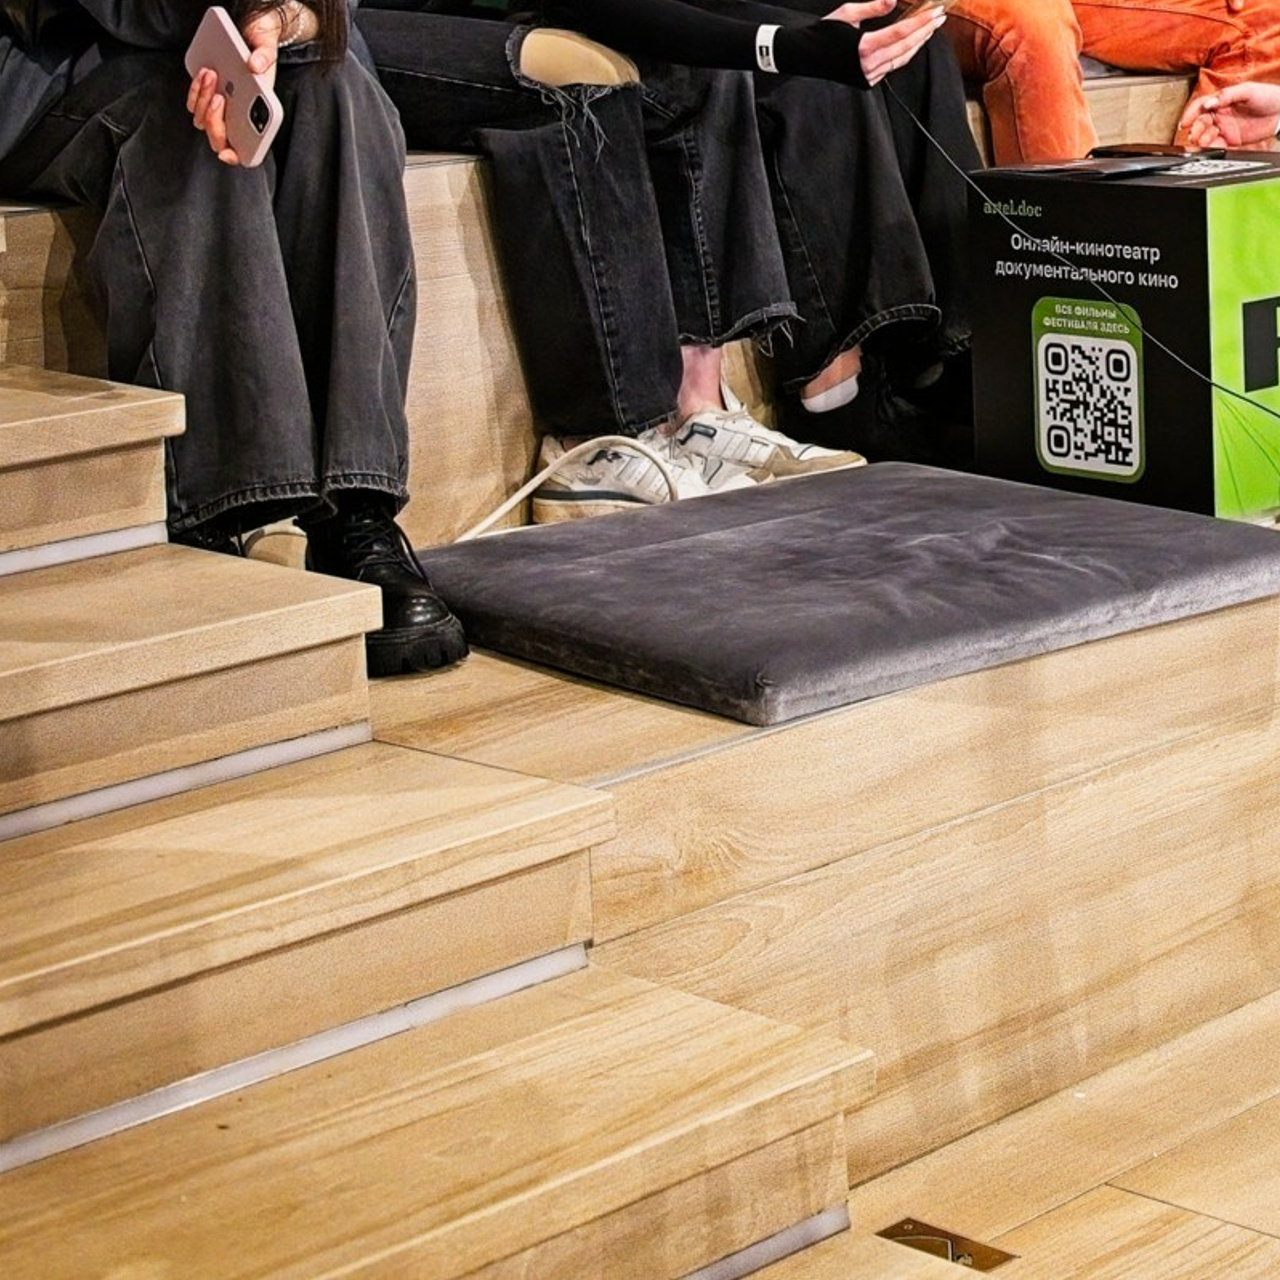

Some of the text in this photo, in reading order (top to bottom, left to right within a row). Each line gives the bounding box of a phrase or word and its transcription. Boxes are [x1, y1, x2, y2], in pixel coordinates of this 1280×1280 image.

[1010, 233, 1161, 264] Онлайн-кинотеатр
[995, 260, 1179, 289] документального кино
[1055, 304, 1117, 319] ВСЕ ФИЛЬМЫ
[1042, 317, 1131, 334] ФЕСТИВАЛЯ ЗДЕСЬ
